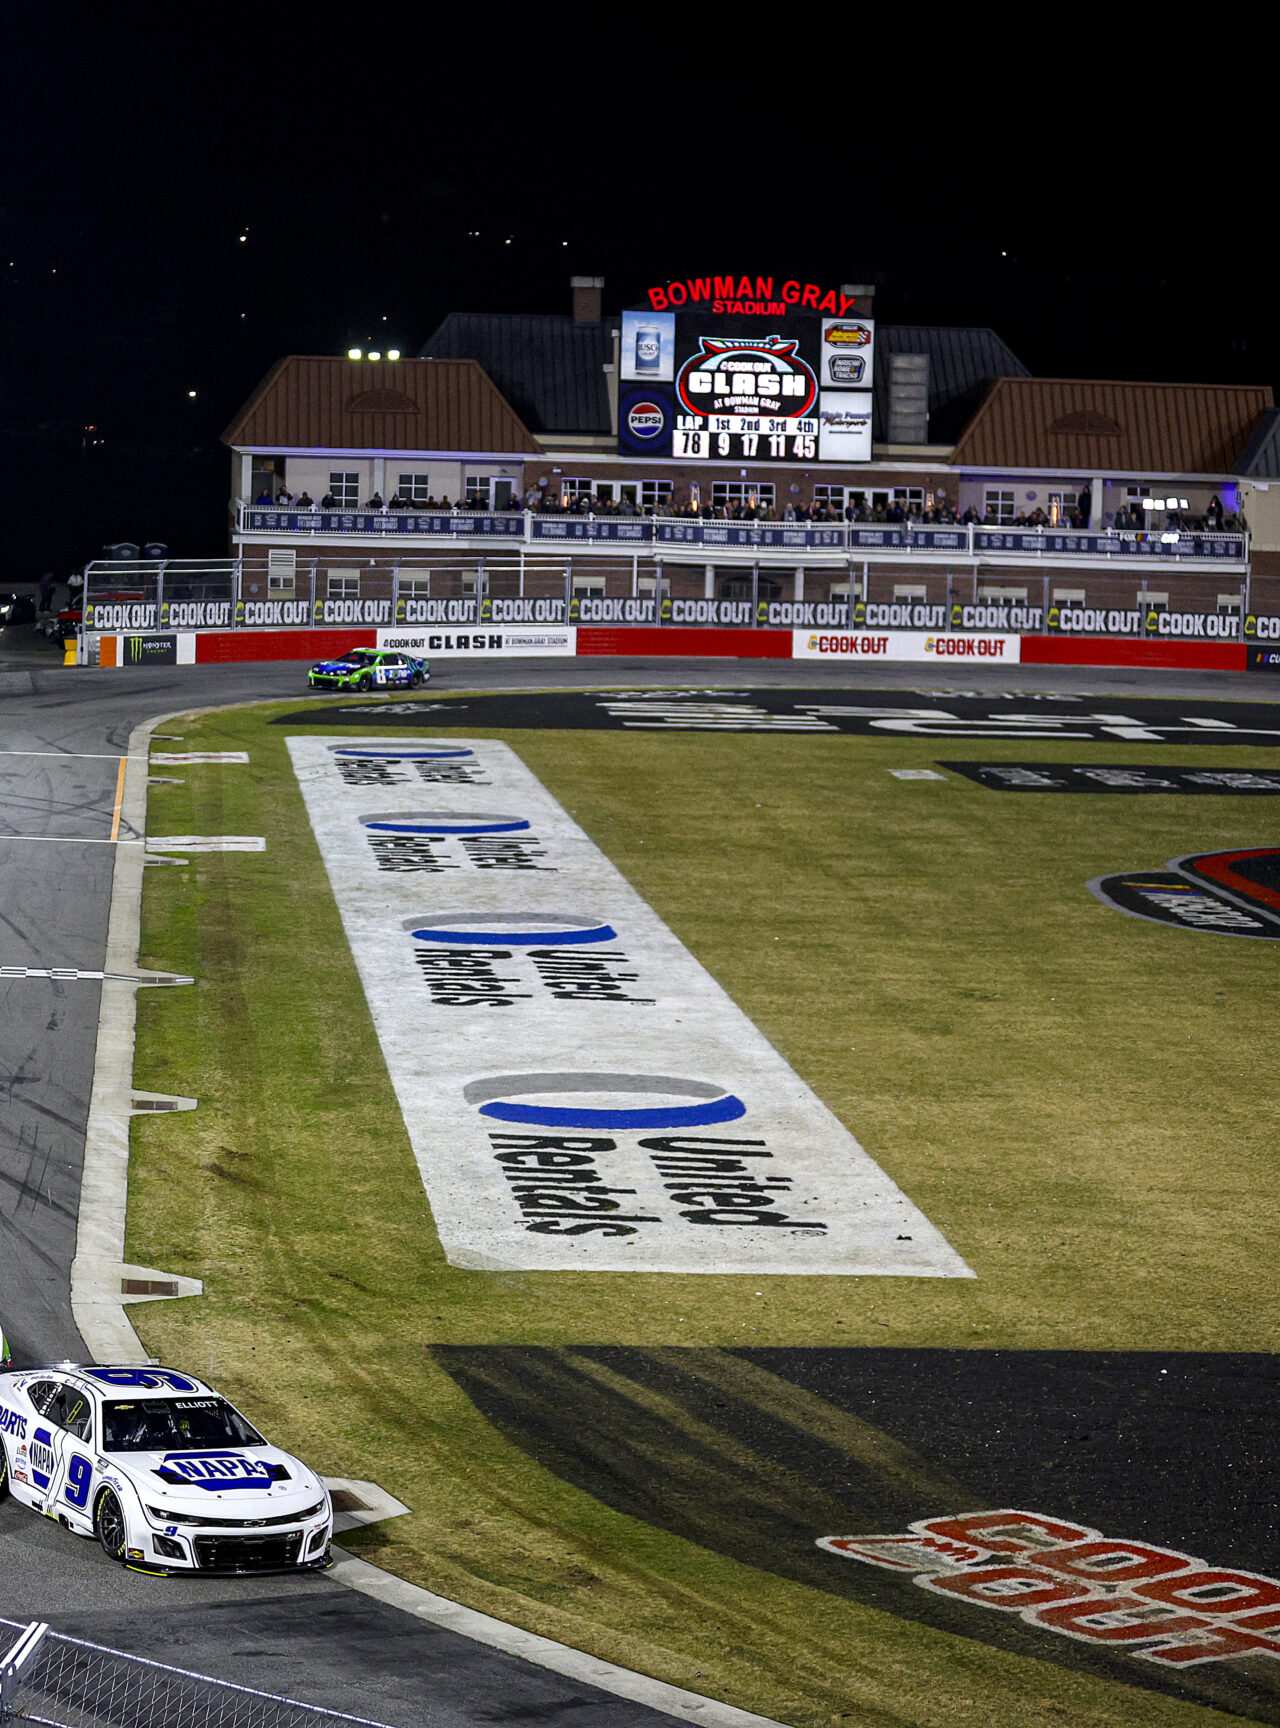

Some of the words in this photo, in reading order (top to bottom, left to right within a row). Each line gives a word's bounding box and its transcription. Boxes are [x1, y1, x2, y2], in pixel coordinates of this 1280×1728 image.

[648, 276, 773, 310] BOWMAN
[782, 280, 856, 317] GRAY
[712, 300, 786, 316] STADIUM
[728, 362, 755, 372] COOK
[688, 372, 806, 396] CLASH
[714, 398, 723, 409] AT
[725, 396, 758, 407] BOWMAN
[760, 396, 781, 411] GRAY
[631, 416, 661, 424] PEPSI
[677, 415, 703, 430] LAP
[716, 418, 731, 431] 1st
[740, 418, 760, 431] 2nd
[769, 419, 787, 432] 3rd
[797, 419, 814, 433] 4th
[682, 433, 701, 454] 78
[719, 433, 730, 456] 9
[741, 434, 759, 457] 17
[768, 435, 786, 457] 11
[793, 435, 816, 458] 45
[94, 605, 131, 628] COOK
[131, 604, 157, 627] OUT
[170, 603, 205, 626] COOK
[205, 602, 231, 625] OUT
[245, 602, 283, 625] COOK
[283, 601, 310, 623] OUT
[324, 601, 363, 622] COOK
[363, 600, 392, 622] OUT
[406, 600, 450, 622] COOK
[450, 600, 478, 621] OUT
[491, 600, 535, 621] COOK
[535, 600, 565, 621] OUT
[580, 599, 624, 621] COOK
[625, 599, 656, 621] OUT
[672, 600, 718, 622] COOK
[720, 601, 752, 623] OUT
[768, 601, 815, 625] COOK
[816, 602, 848, 625] OUT
[865, 603, 913, 627] COOK
[913, 604, 945, 628] OUT
[962, 605, 1011, 629] COOK
[1011, 606, 1043, 630] OUT
[1059, 608, 1107, 632] COOK
[1108, 609, 1141, 633] OUT
[1158, 612, 1206, 635] COOK
[1206, 613, 1239, 637] OUT
[143, 641, 171, 650] MONSTER
[390, 638, 410, 648] COOK
[410, 638, 426, 647] OUT
[429, 634, 503, 650] CLASH
[819, 636, 858, 653] COOK
[861, 636, 889, 654] OUT
[936, 638, 974, 656] COOK
[978, 639, 1006, 656] OUT
[376, 667, 387, 684] 8
[414, 949, 533, 1007] Rentals
[527, 949, 656, 1005] United
[488, 1133, 662, 1238] Rentals
[637, 1135, 828, 1230] United
[175, 1401, 218, 1409] ELLIOTT
[33, 1442, 53, 1475] NAPA
[173, 1459, 263, 1478] NAPA
[64, 1452, 93, 1510] 9
[163, 1526, 179, 1536] 9
